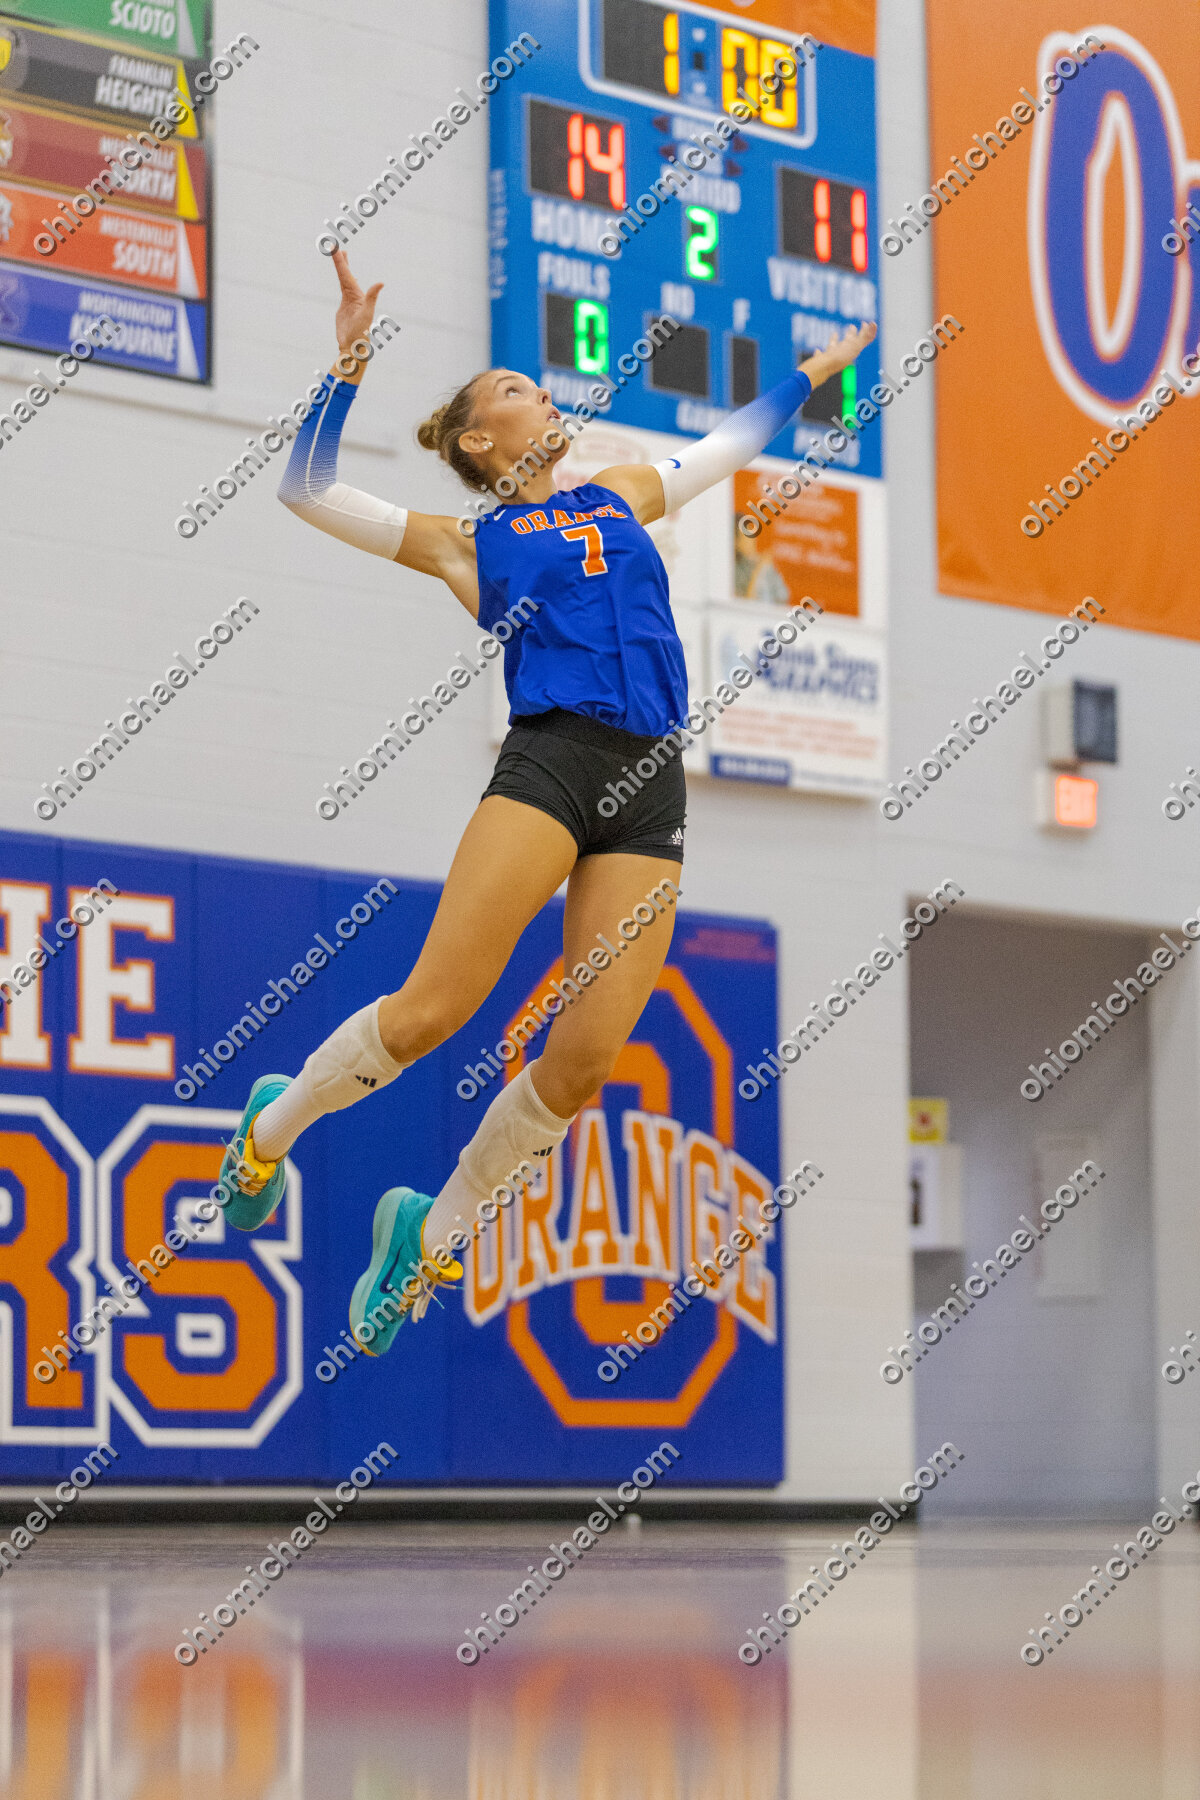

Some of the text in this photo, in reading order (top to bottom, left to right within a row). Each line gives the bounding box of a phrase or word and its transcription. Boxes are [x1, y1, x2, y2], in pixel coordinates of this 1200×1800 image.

[109, 0, 176, 38] SCIOTO
[567, 113, 625, 210] 14
[112, 240, 176, 280] SOUTH
[685, 205, 718, 281] 2
[813, 178, 867, 272] 11
[1027, 25, 1200, 430] O
[69, 312, 177, 362] KOURNE
[574, 299, 609, 376] 0
[510, 504, 628, 535] ORANGE
[560, 523, 608, 577] 7
[463, 1108, 776, 1345] ORANGE
